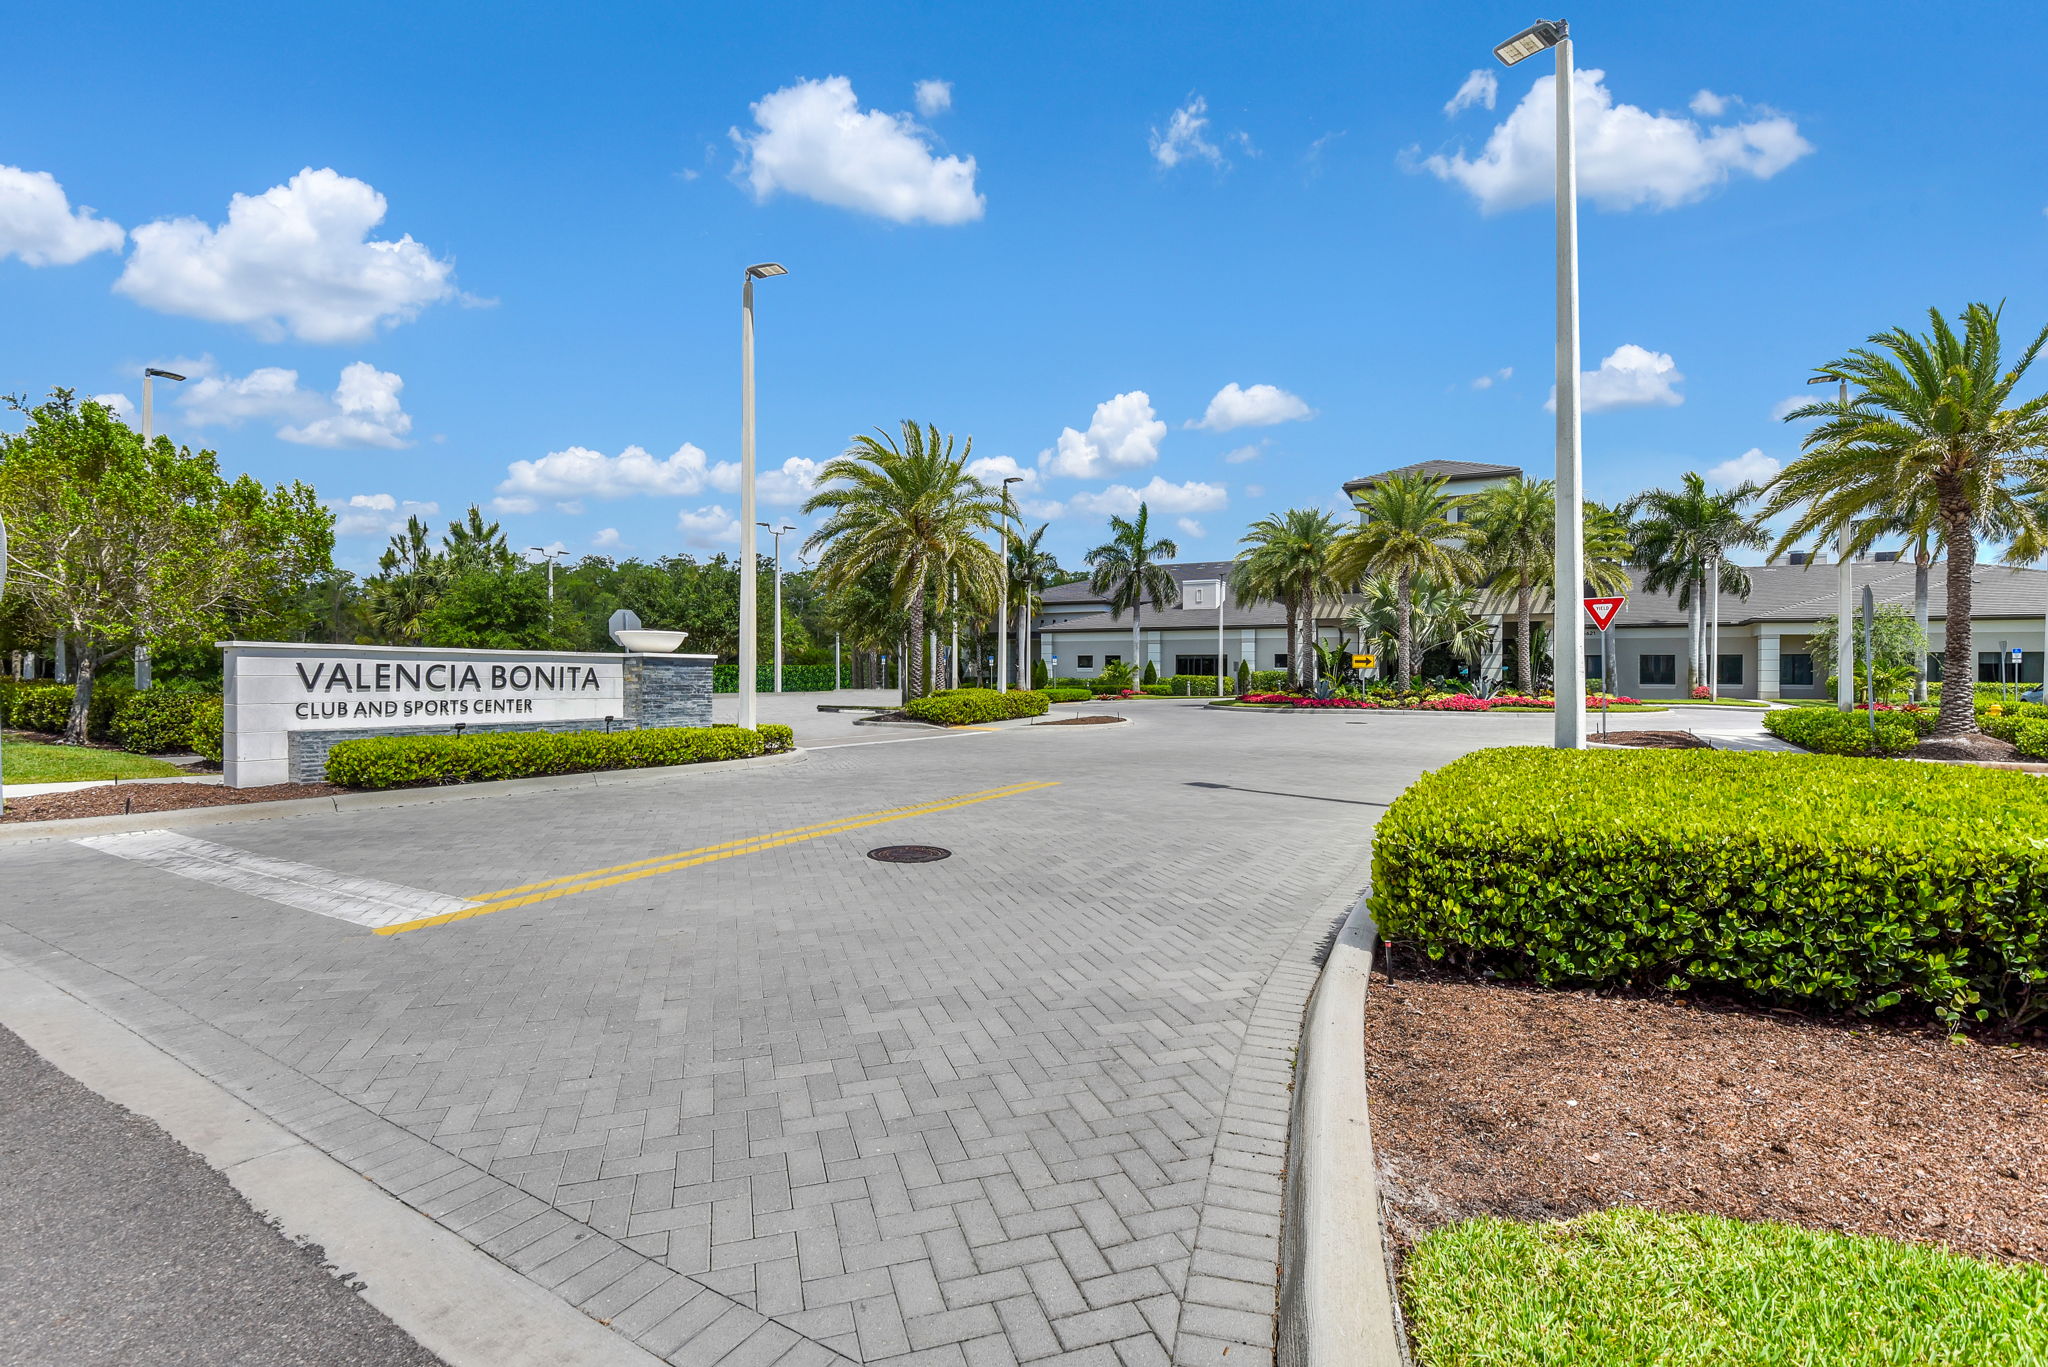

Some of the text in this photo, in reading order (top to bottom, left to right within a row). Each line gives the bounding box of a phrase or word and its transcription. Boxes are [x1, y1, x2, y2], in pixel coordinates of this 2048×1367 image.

[296, 662, 600, 692] VALENCIA BONITA
[295, 699, 533, 718] CLUB AND SPORTS CENTER
